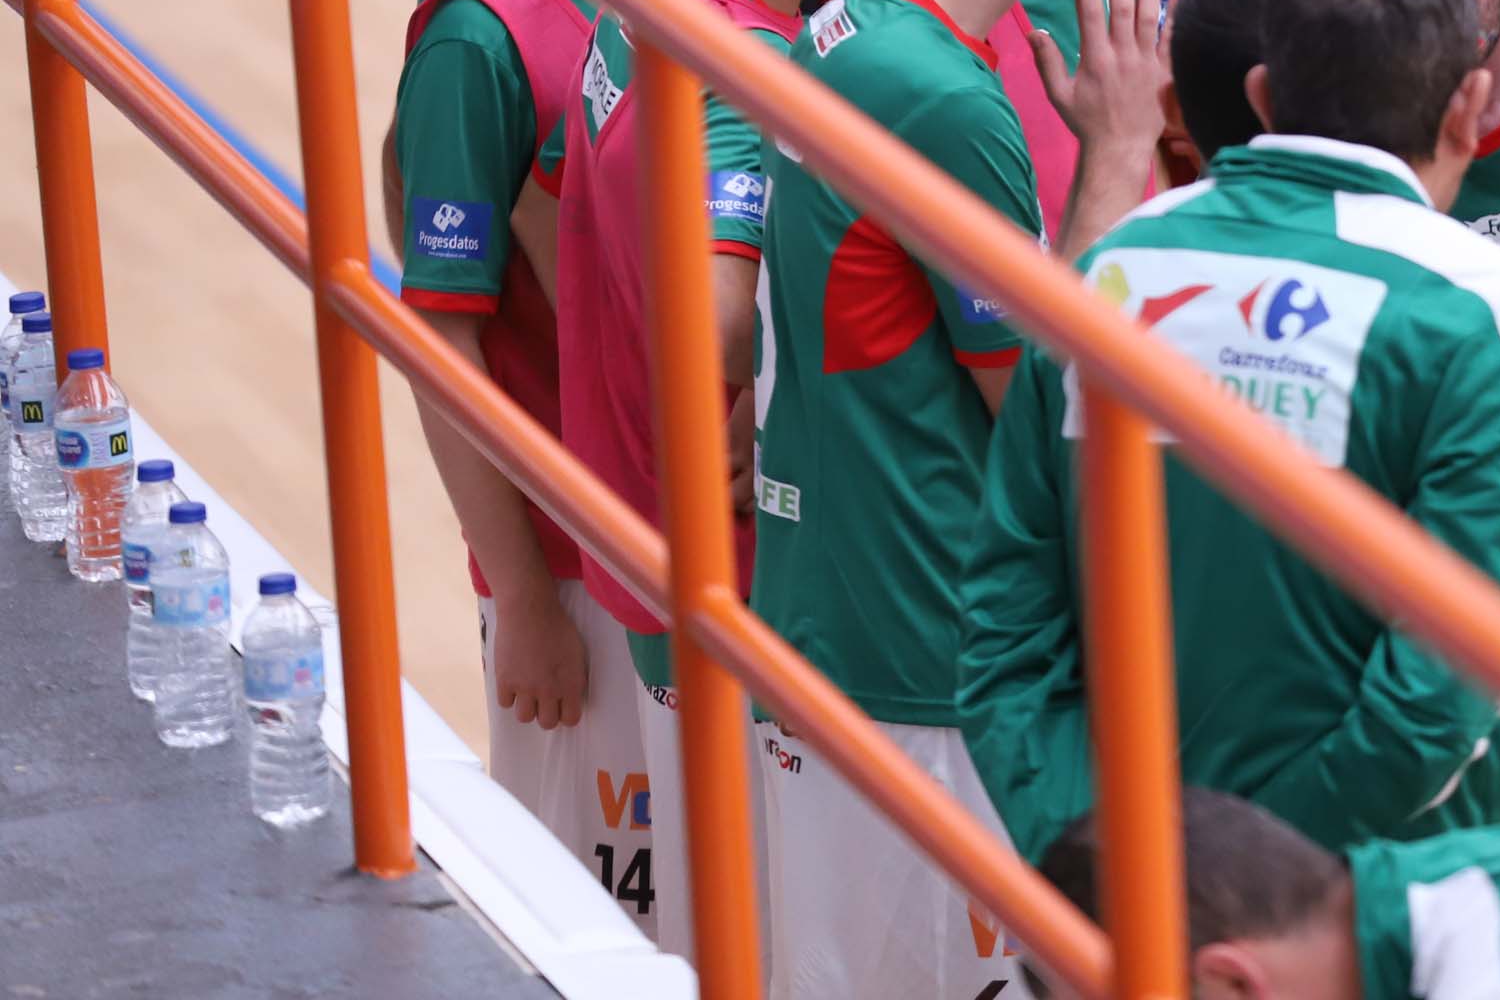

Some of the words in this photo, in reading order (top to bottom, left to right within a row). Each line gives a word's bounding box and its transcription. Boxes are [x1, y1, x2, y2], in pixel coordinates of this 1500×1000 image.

[418, 230, 479, 251] Progesdatos
[1218, 346, 1328, 378] Carrefour
[595, 843, 655, 914] 14
